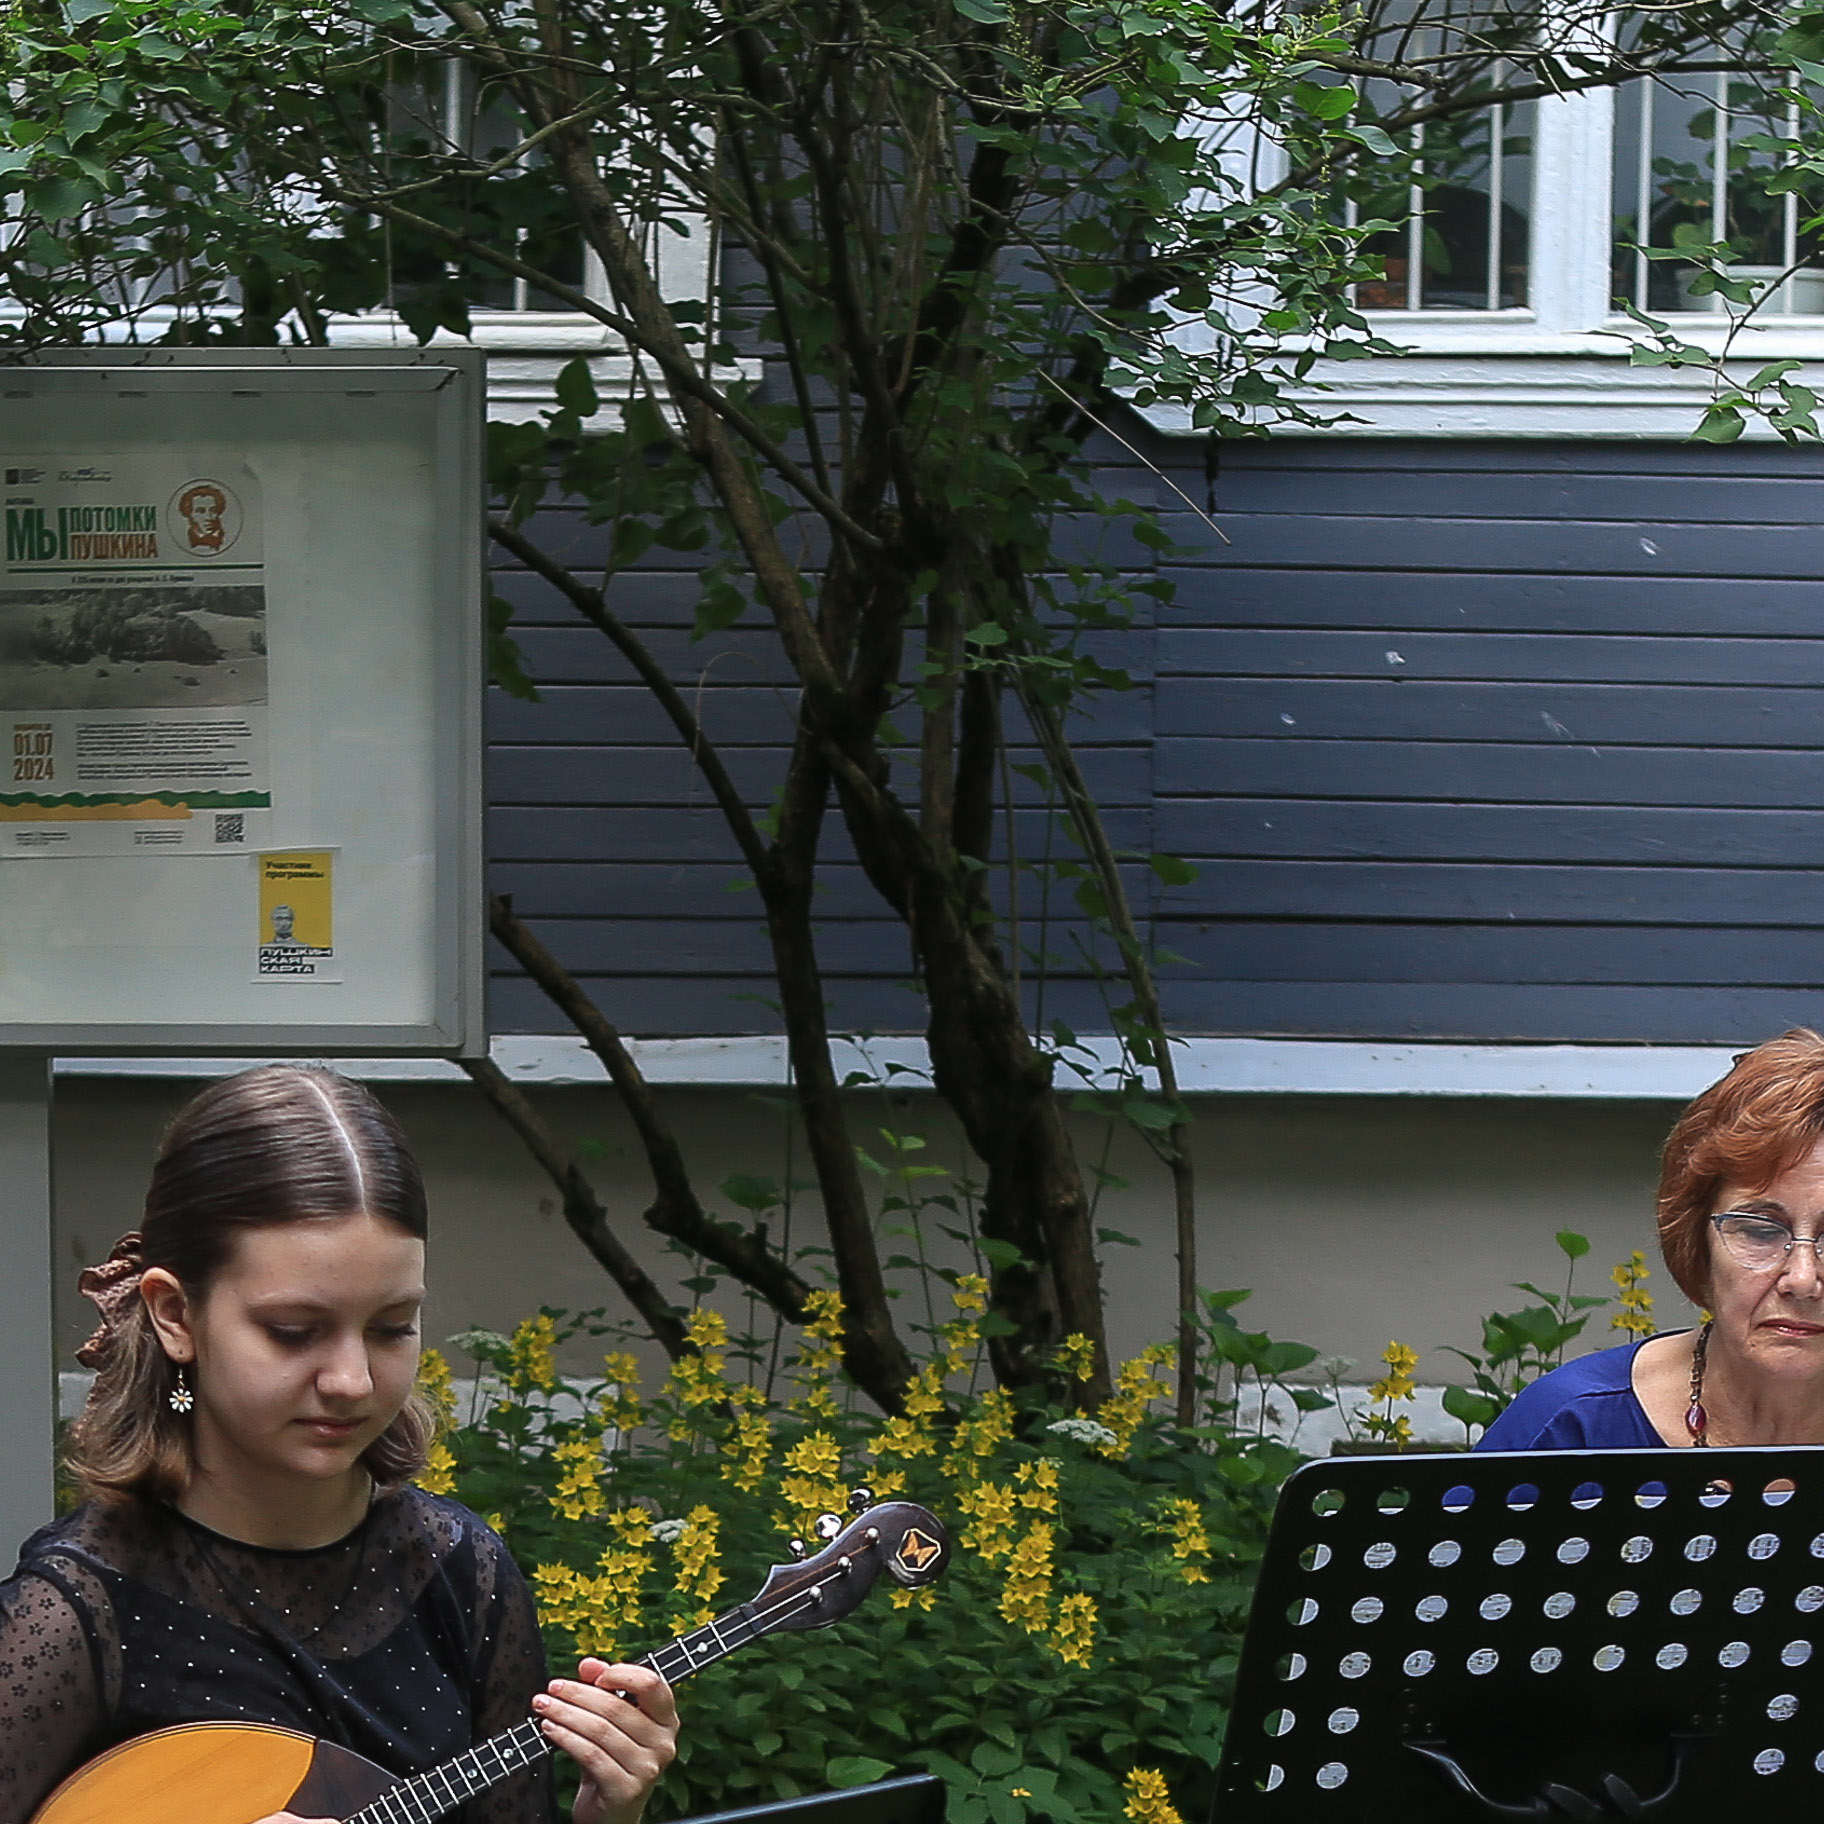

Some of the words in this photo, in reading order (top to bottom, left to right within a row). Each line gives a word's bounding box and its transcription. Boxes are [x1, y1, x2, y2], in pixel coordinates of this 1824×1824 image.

[70, 505, 156, 533] ПОТОМКИ
[6, 506, 68, 561] МЫ
[71, 533, 158, 560] ПУШКИНА
[14, 733, 53, 756] 01.07
[14, 757, 55, 781] 2024
[260, 948, 332, 956] ПУШКИН
[260, 957, 301, 965] СКАЯ
[260, 965, 312, 973] КАРТА
